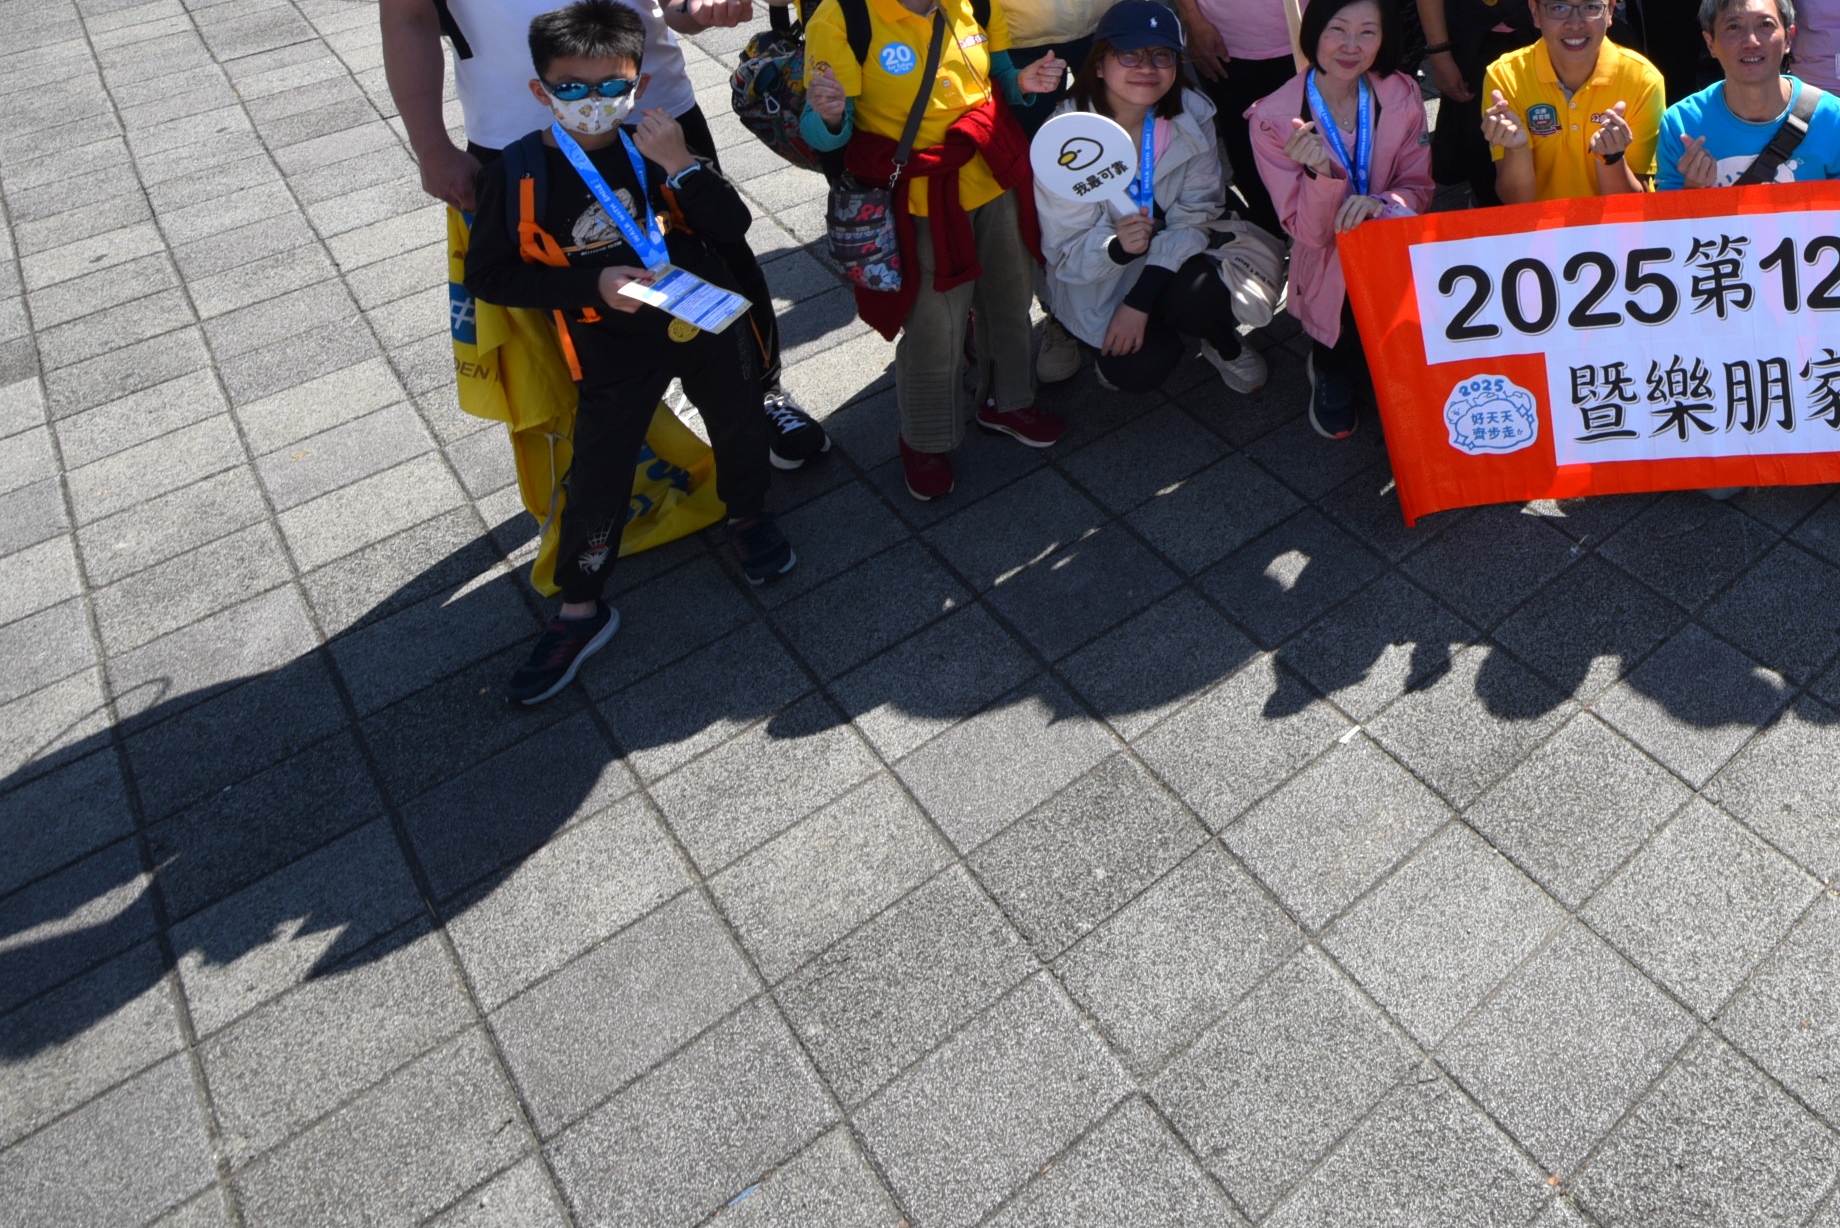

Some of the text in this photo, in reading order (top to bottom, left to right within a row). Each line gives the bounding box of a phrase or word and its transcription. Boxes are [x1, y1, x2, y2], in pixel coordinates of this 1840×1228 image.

[882, 45, 911, 64] 20
[1072, 160, 1129, 197] 我最可靠
[1458, 378, 1505, 398] 2025
[1471, 410, 1514, 426] 好天天
